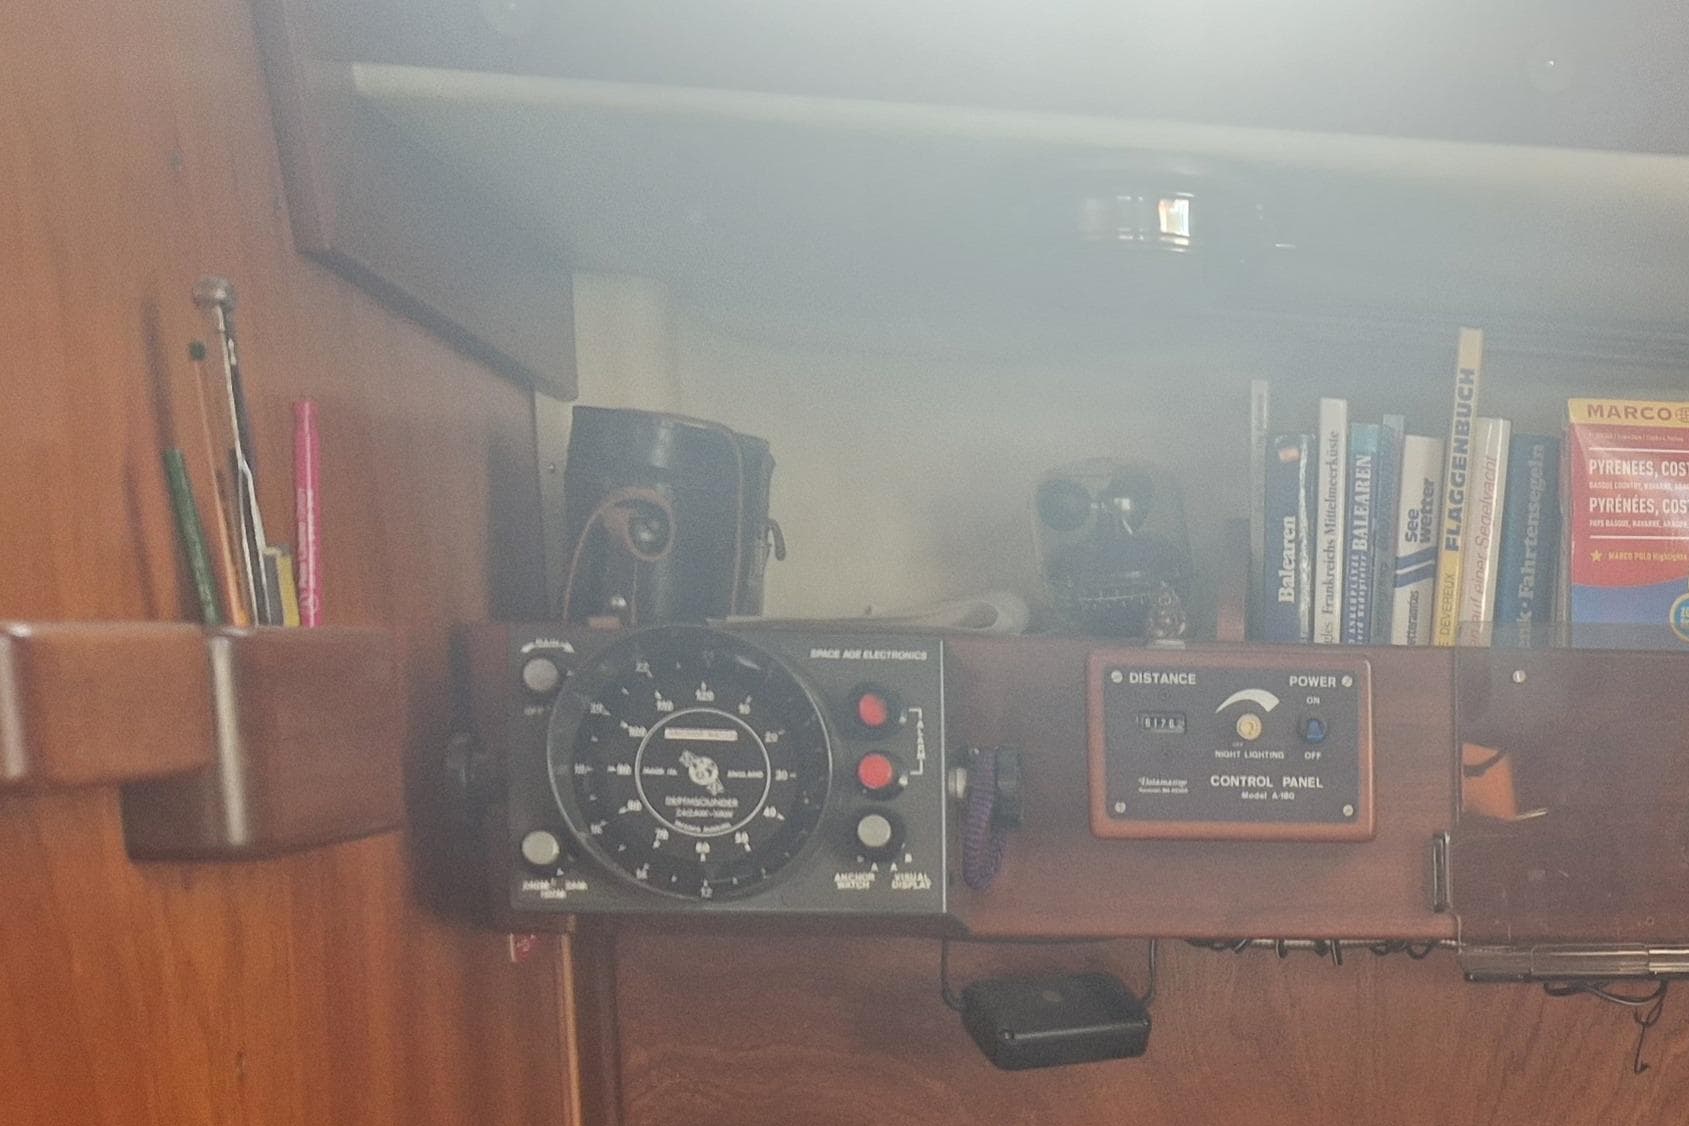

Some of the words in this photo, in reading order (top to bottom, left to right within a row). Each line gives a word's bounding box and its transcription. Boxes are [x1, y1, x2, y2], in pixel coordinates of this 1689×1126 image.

[1587, 404, 1672, 421] MARCO
[1446, 368, 1475, 551] FLAGGENBUCH
[1588, 459, 1659, 479] PYRENEES,
[1324, 430, 1340, 536] Mittelmeerküste
[1351, 454, 1372, 552] BALEAREN
[1420, 478, 1435, 543] wetter
[1588, 494, 1660, 515] PYRÉNÉES,
[1405, 508, 1420, 543] See
[1518, 445, 1546, 600] Fahrtensegeln
[1279, 516, 1297, 604] Balearen
[1321, 538, 1336, 615] Frankreichs
[1439, 572, 1456, 634] DEVEREUX
[1466, 597, 1483, 623] auf
[810, 648, 840, 659] SPACE
[842, 649, 861, 660] AGE
[863, 649, 928, 661] ELECTRONICS
[1129, 672, 1197, 685] DISTANCE
[1289, 675, 1337, 688] POWER
[1306, 696, 1320, 705] ON
[1214, 750, 1241, 760] NIGHT
[1244, 751, 1285, 760] LIGHTING
[1304, 751, 1322, 761] OFF
[1210, 775, 1274, 788] CONTROL
[1282, 776, 1324, 789] PANEL
[1241, 791, 1267, 800] Model
[834, 872, 876, 881] ANCHOR
[836, 880, 871, 890] WATCH
[891, 880, 932, 890] DISPLAY
[893, 872, 929, 882] VISUAL
